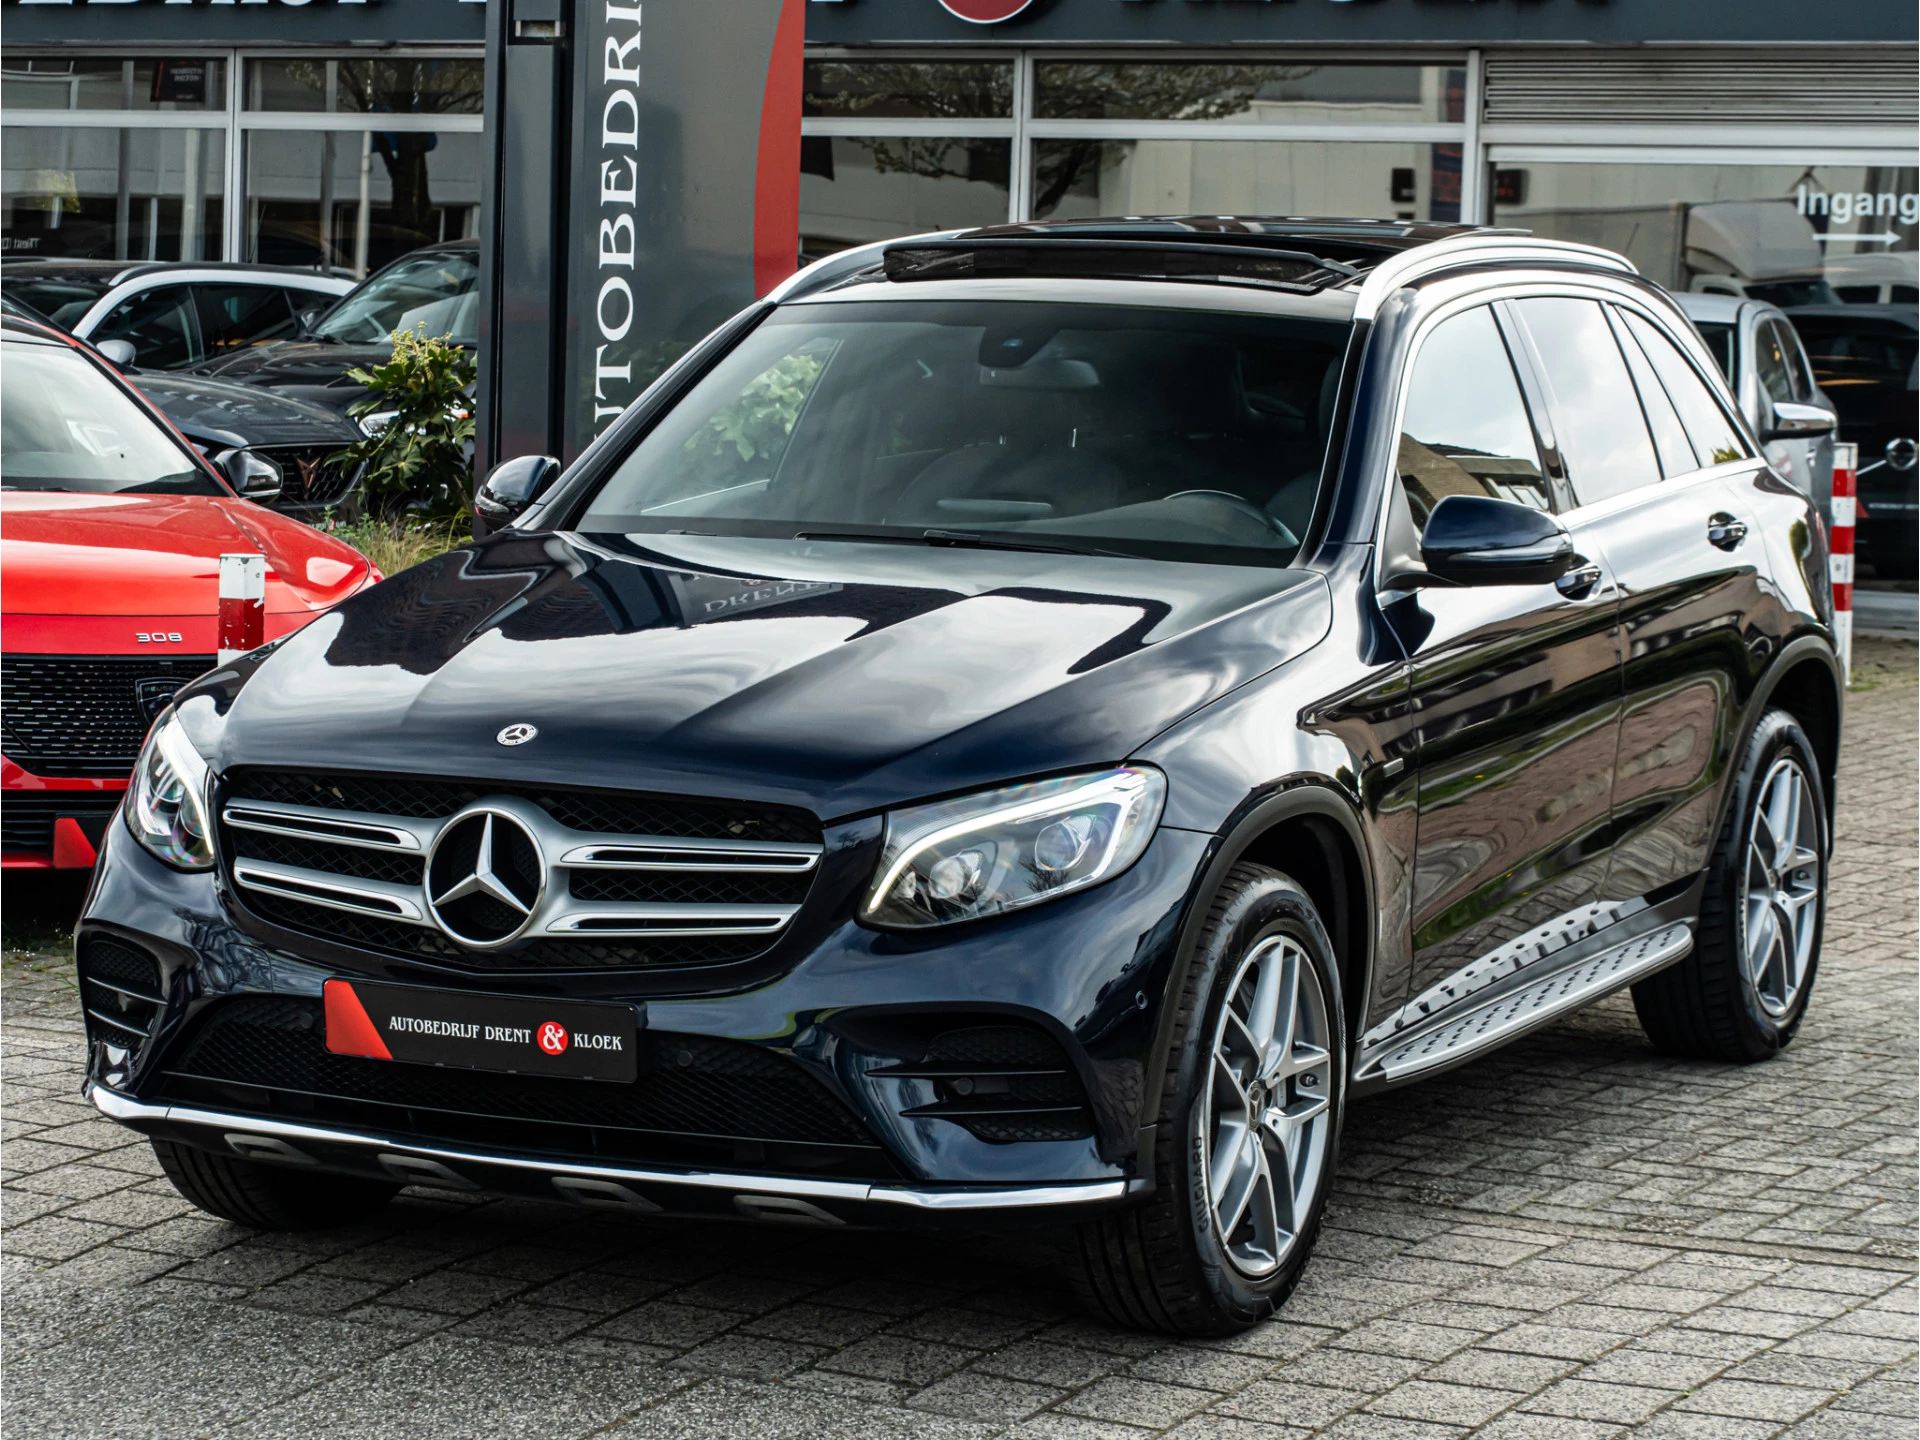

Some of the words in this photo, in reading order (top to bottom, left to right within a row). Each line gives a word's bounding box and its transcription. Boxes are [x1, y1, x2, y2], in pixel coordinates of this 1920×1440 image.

[594, 0, 642, 440] TOBEDRI
[1797, 184, 1919, 225] Ingang
[136, 632, 183, 642] 308
[389, 1016, 480, 1039] AUTOBEDRIJF
[484, 1025, 531, 1044] DRENT
[543, 1024, 564, 1050] &
[573, 1033, 622, 1050] KLOEK
